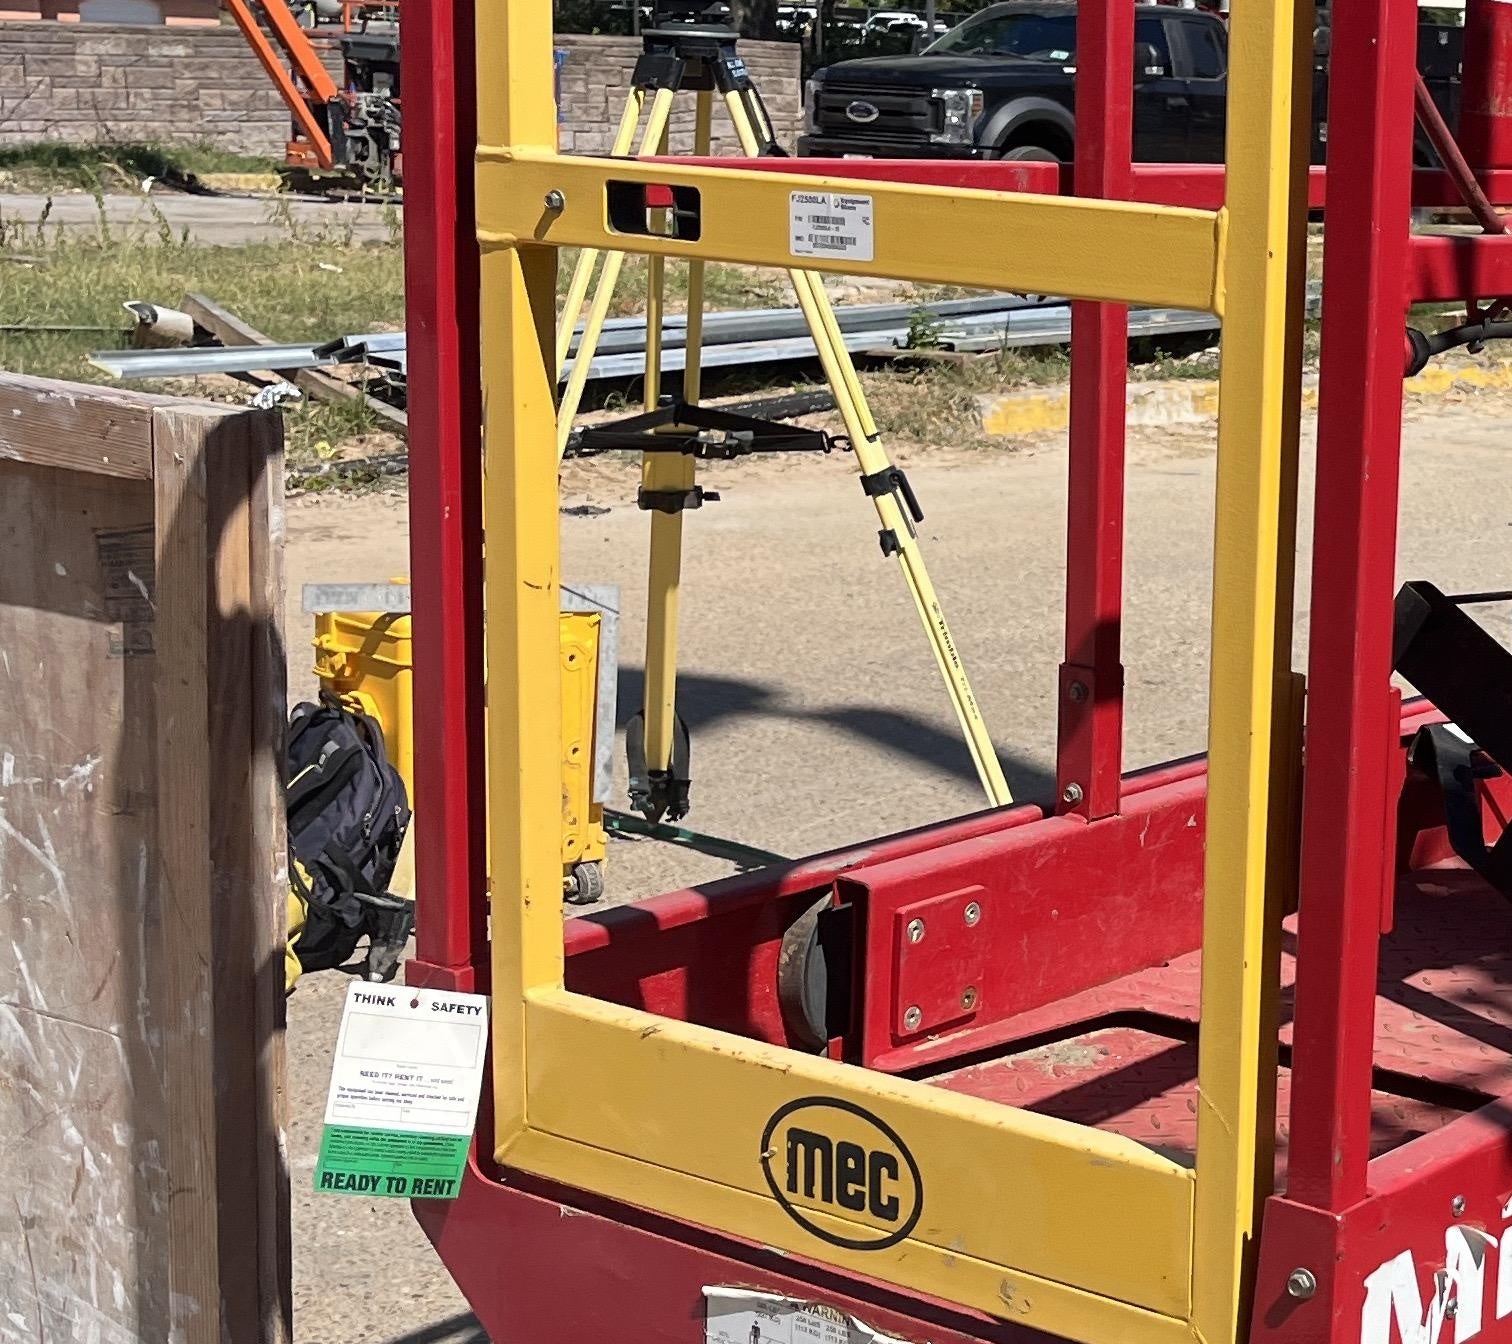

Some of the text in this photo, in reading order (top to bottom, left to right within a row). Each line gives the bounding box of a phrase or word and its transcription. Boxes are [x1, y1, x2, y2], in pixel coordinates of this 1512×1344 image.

[353, 992, 482, 1016] THINK SAFETY
[321, 1171, 457, 1196] READY TO RENT
